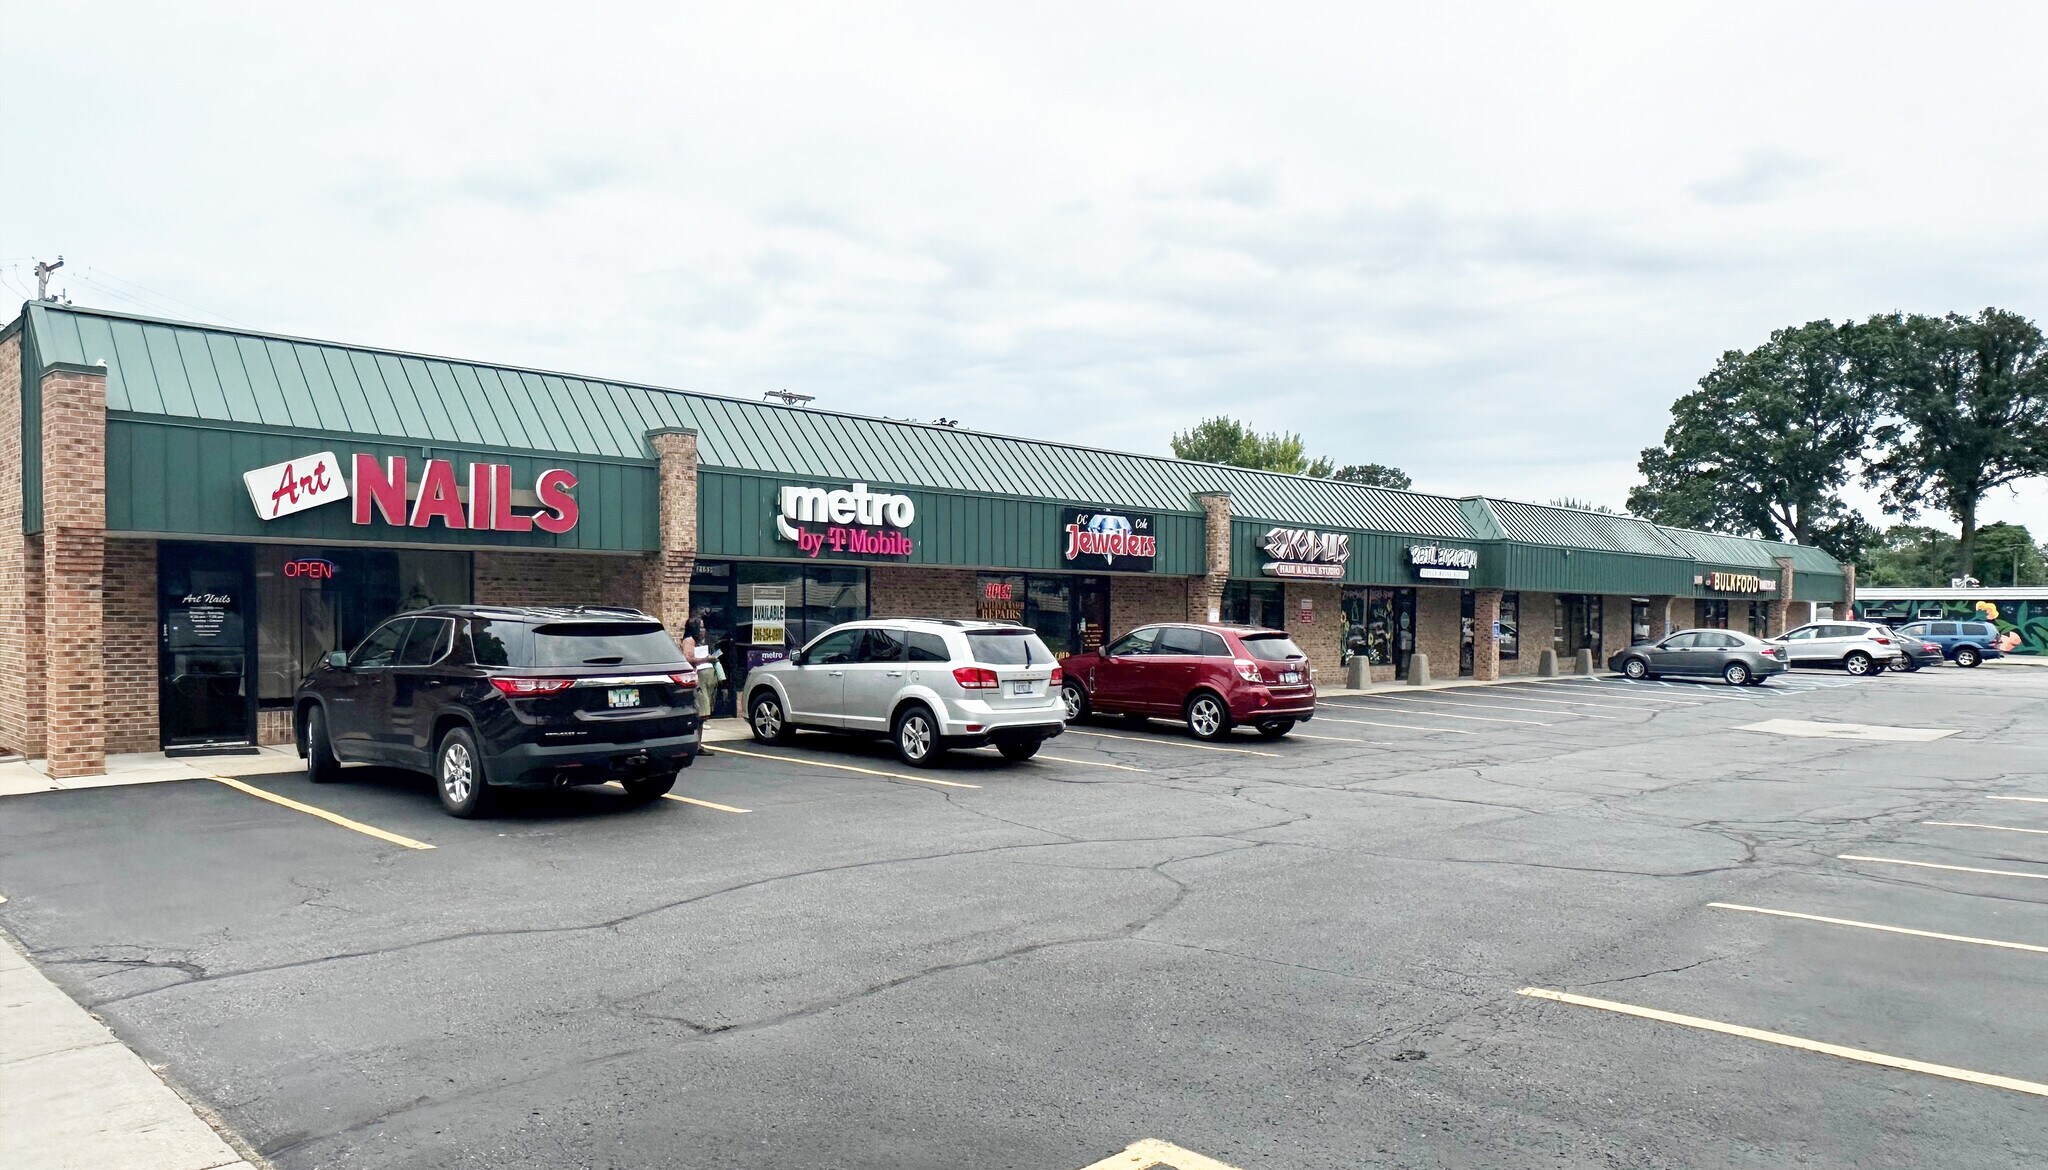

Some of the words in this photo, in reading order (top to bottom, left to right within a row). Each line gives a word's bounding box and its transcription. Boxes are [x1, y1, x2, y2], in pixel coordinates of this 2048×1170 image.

[271, 461, 332, 517] Art
[351, 453, 580, 535] NAILS
[778, 483, 916, 536] metro
[798, 526, 825, 559] by
[849, 528, 914, 557] Mobile
[1065, 523, 1157, 561] Jewelers
[1263, 527, 1351, 564] EXODUS
[284, 560, 333, 580] OPEN
[1280, 564, 1296, 575] HAIR
[1303, 566, 1318, 576] NAIL
[1319, 567, 1341, 577] STUDIO
[181, 593, 202, 604] Art
[203, 593, 231, 604] Nails
[985, 582, 1013, 600] OPEN
[753, 604, 784, 621] AVAILABLE
[981, 608, 1022, 620] REPAIRS
[761, 651, 783, 661] metro
